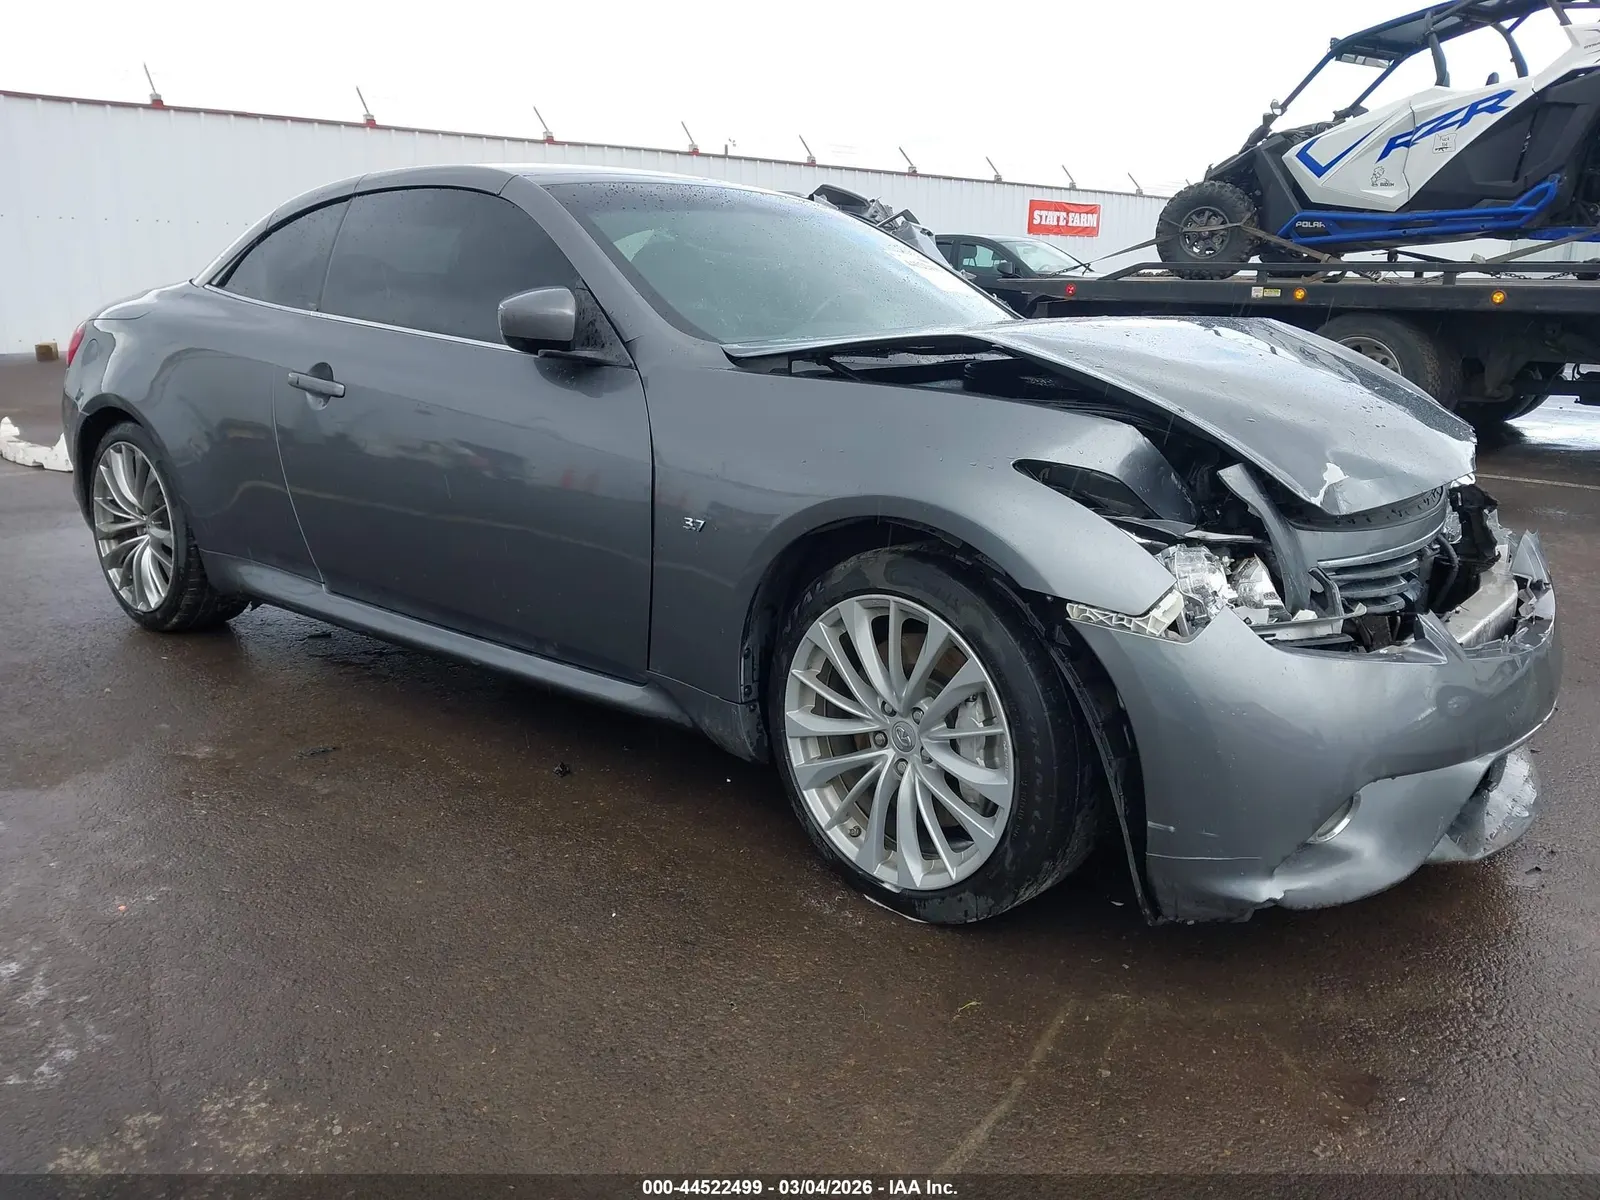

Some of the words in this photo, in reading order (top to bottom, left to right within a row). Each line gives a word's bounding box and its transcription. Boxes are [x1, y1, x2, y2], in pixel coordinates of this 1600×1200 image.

[1375, 89, 1517, 163] RZR
[1033, 210, 1066, 226] STATE
[1067, 212, 1097, 228] FARM
